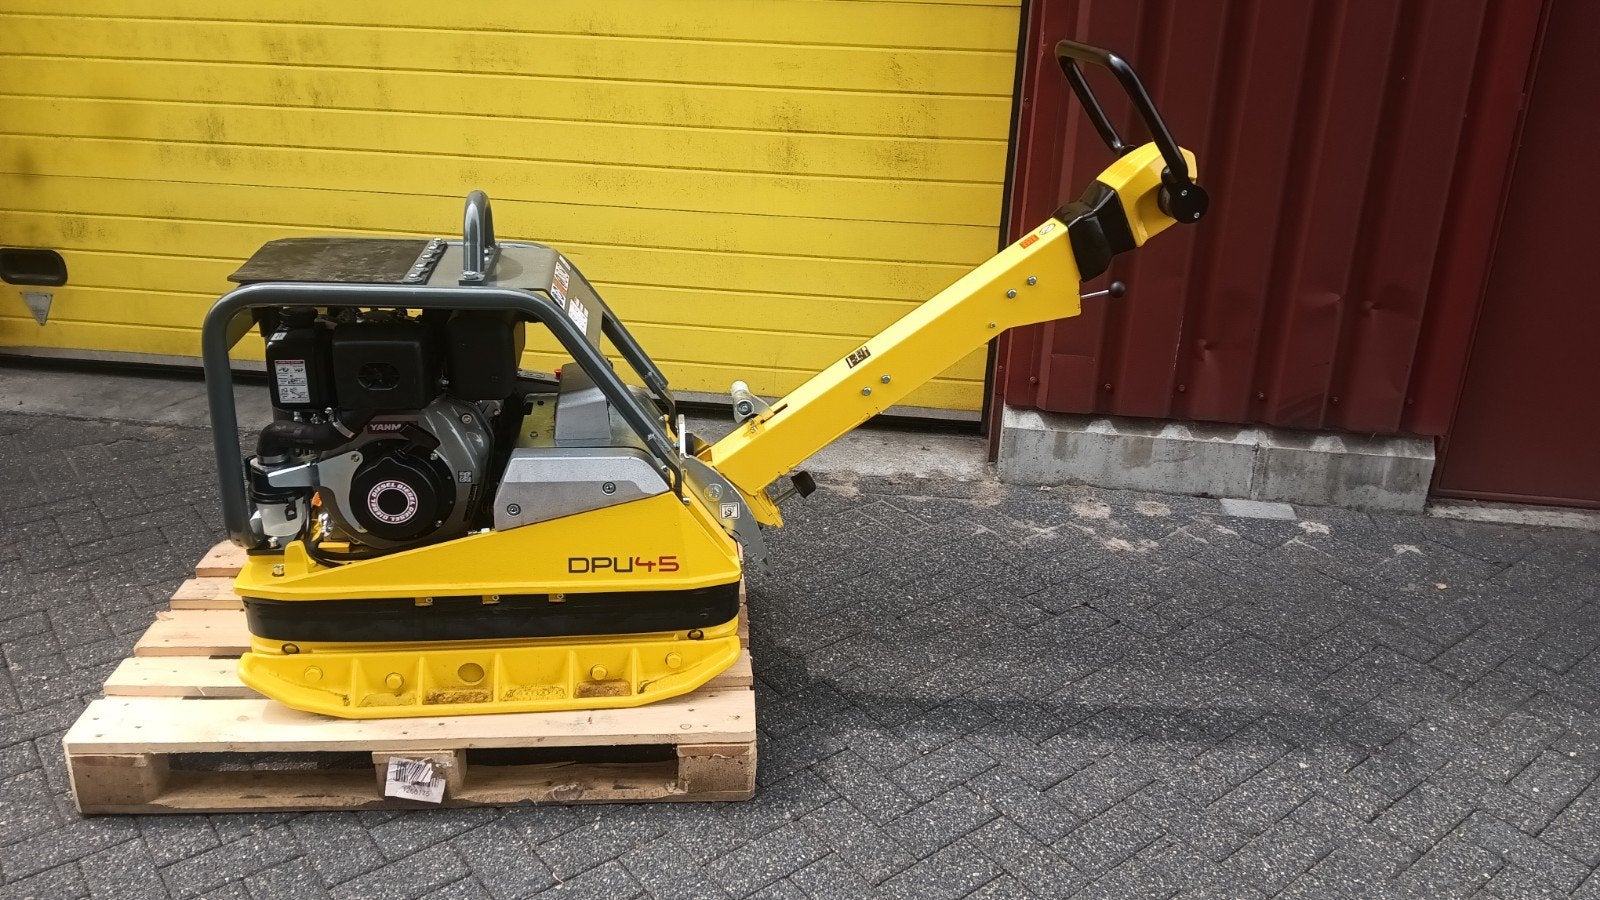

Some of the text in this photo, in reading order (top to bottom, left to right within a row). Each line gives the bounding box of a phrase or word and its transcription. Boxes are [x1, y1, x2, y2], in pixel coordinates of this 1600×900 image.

[370, 423, 401, 431] YANM
[371, 482, 396, 498] DIESEL
[396, 483, 416, 505] DIESEL
[568, 556, 680, 573] DPU45
